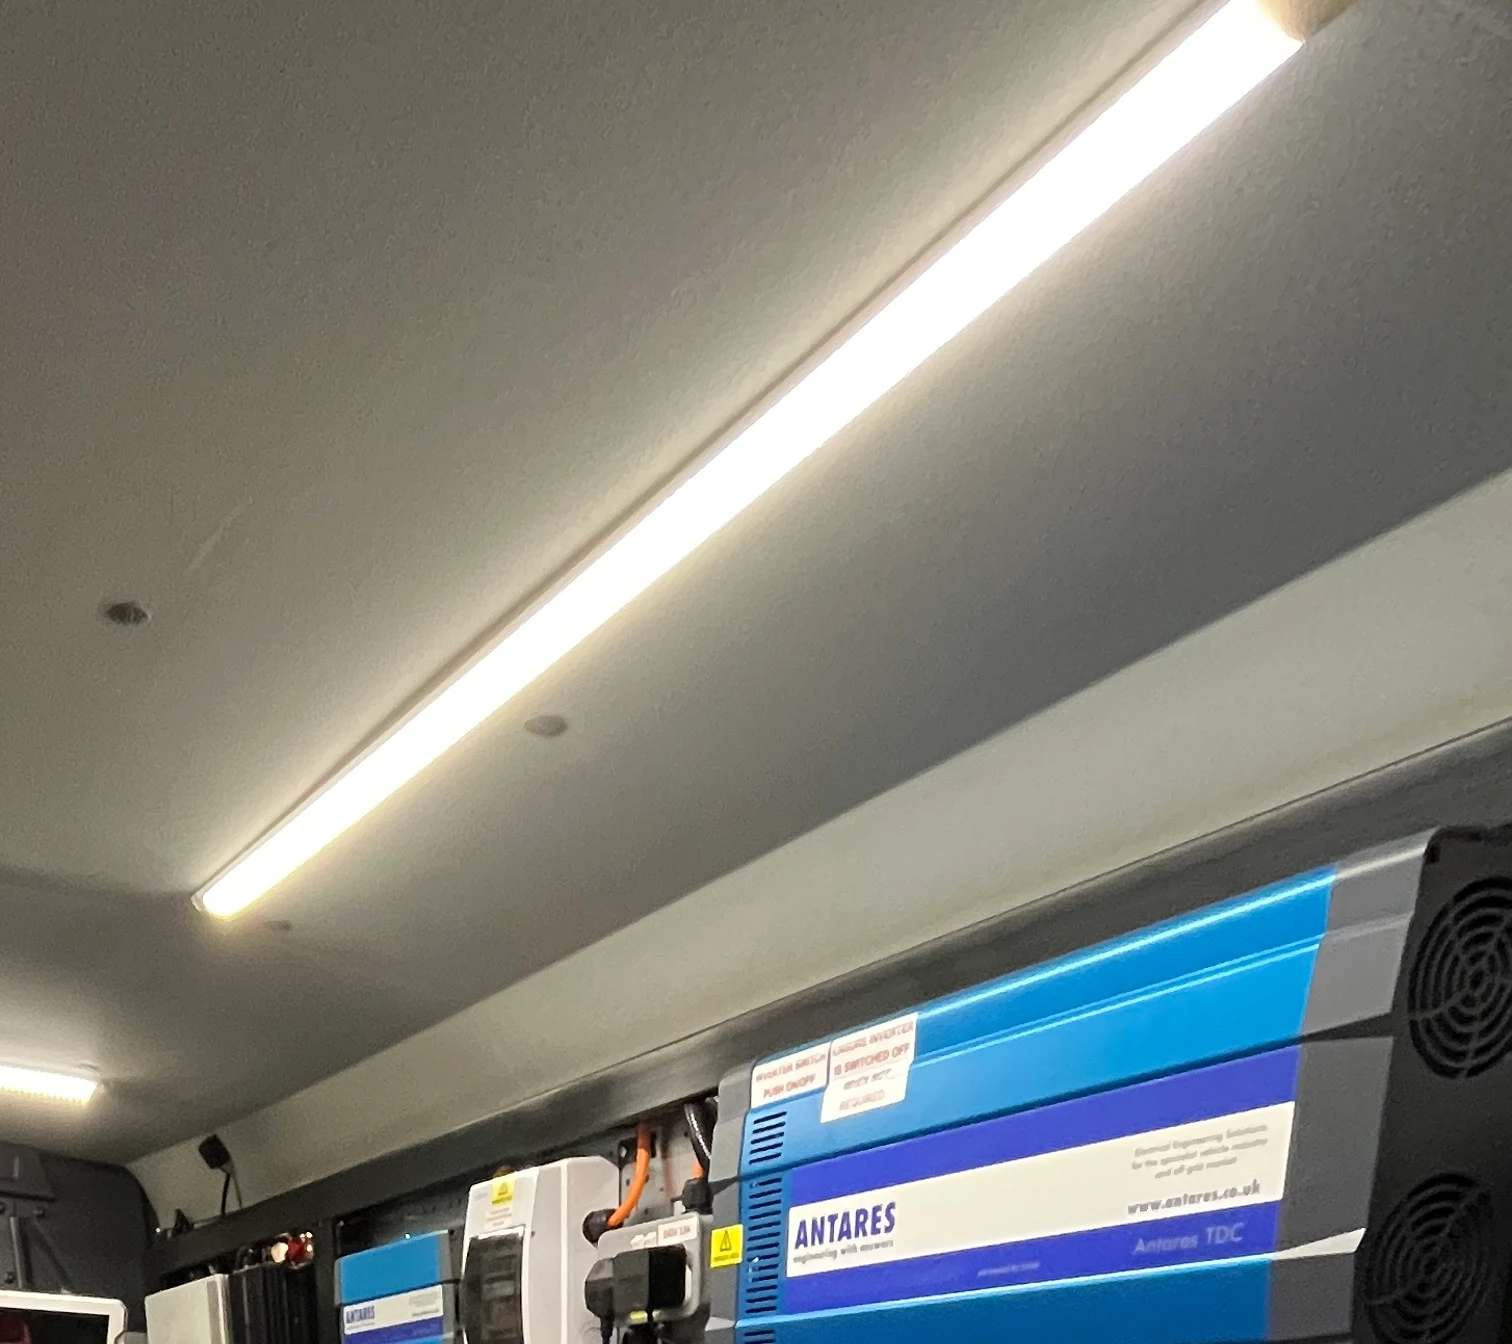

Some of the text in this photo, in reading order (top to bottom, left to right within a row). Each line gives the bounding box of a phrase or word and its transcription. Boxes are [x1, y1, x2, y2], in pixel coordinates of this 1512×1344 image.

[844, 1049, 890, 1074] SWITCHED
[891, 1042, 911, 1058] OFF
[763, 1084, 785, 1099] PUSH
[1127, 1178, 1261, 1215] www.antares.co.uk
[794, 1201, 896, 1250] ANTARES
[1132, 1222, 1245, 1256] Antares TDC
